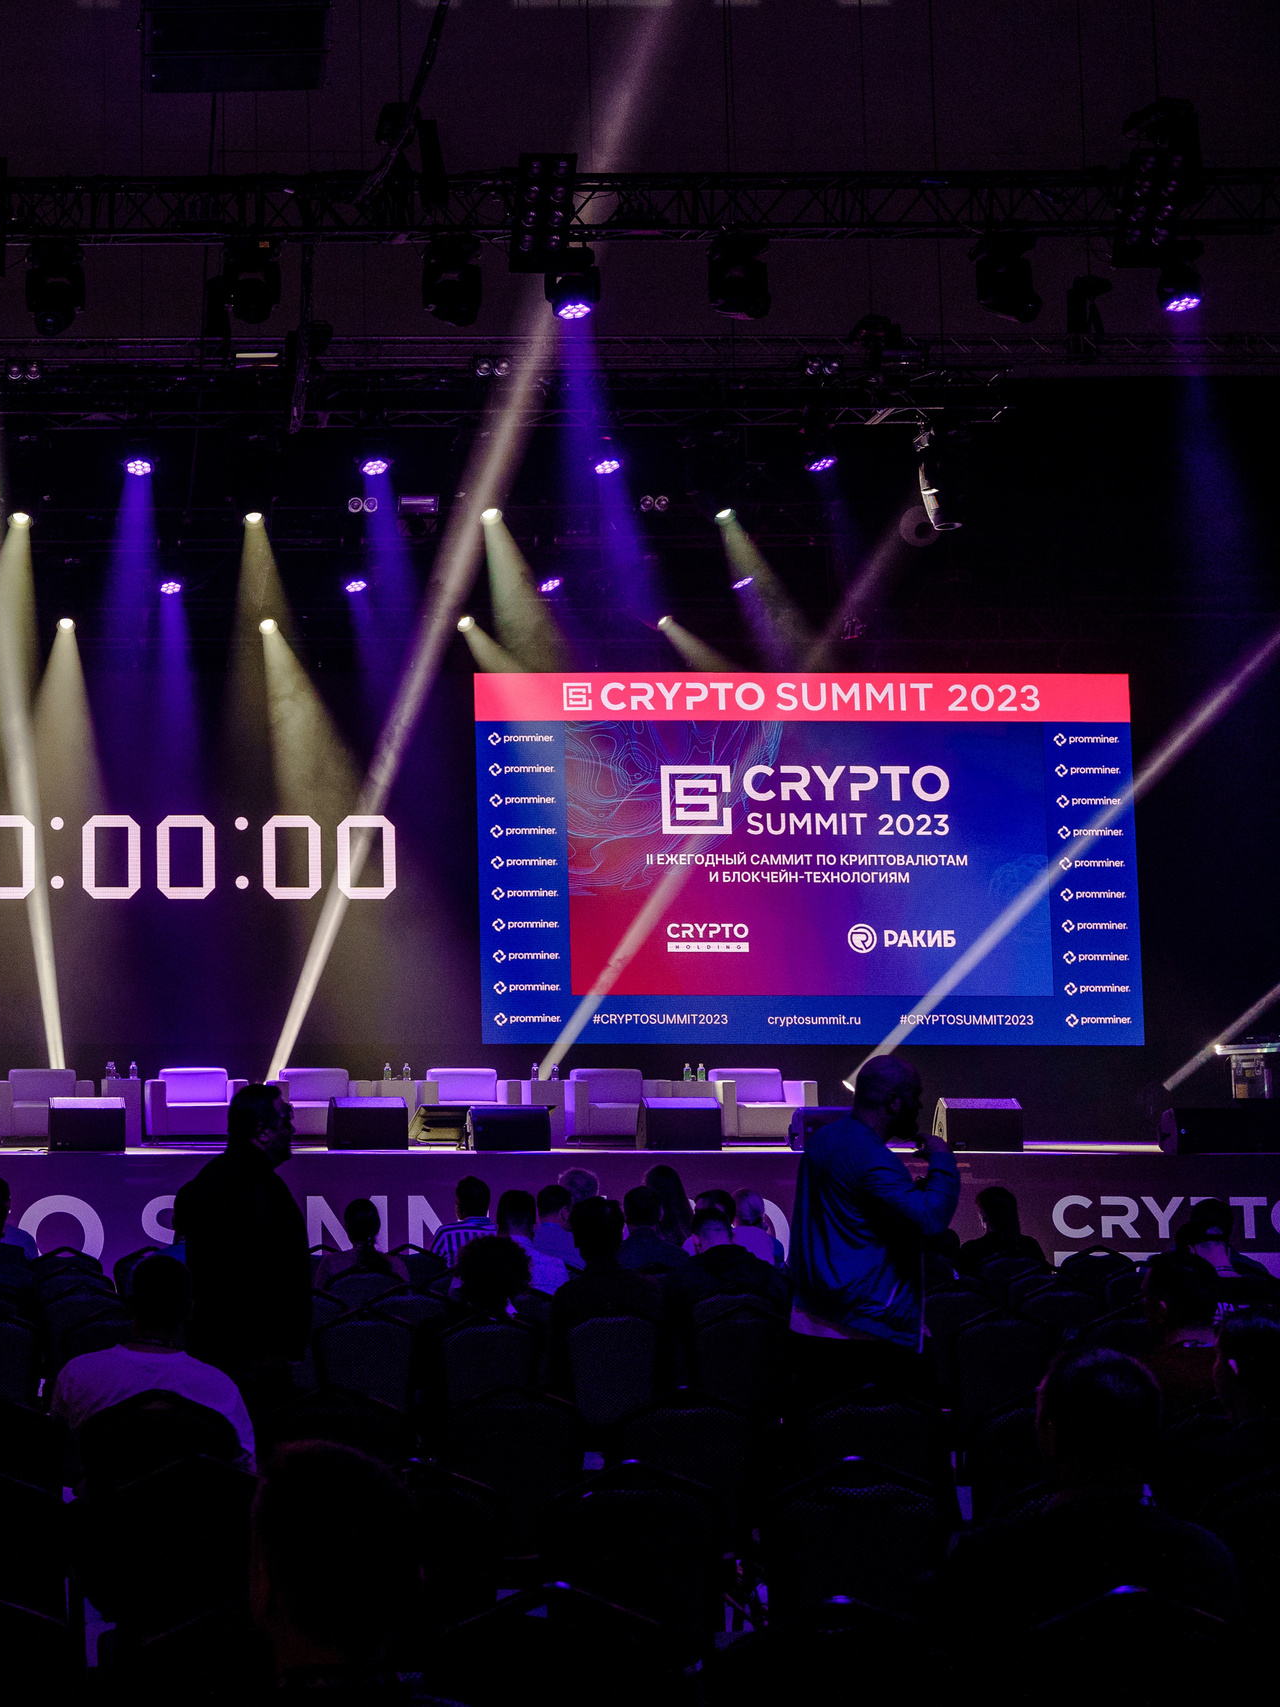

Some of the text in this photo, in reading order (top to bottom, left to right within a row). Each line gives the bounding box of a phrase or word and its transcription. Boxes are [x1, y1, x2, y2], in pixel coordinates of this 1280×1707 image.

[601, 682, 765, 710] CRYPTO
[777, 683, 933, 711] SUMMIT
[948, 685, 1040, 711] 2023
[743, 764, 949, 801] CRYPTO
[747, 813, 949, 835] SUMMIT 2023
[657, 852, 746, 867] ЕЖЕГОДНЫЙ
[751, 854, 812, 865] САММИТ
[817, 855, 836, 865] ПО
[840, 854, 967, 865] КРИПТОВАЛЮТАМ
[710, 870, 909, 883] И БЛОКЧЕЙН-ТЕХНОЛОГИЯМ
[667, 923, 748, 938] CRYPTO
[884, 930, 956, 947] РАКИБ
[593, 1014, 728, 1024] #CRYPTOSUMMIT2023
[768, 1015, 860, 1026] cryptosummit.ru
[901, 1015, 1033, 1025] #CRYPTOSUMMIT2023
